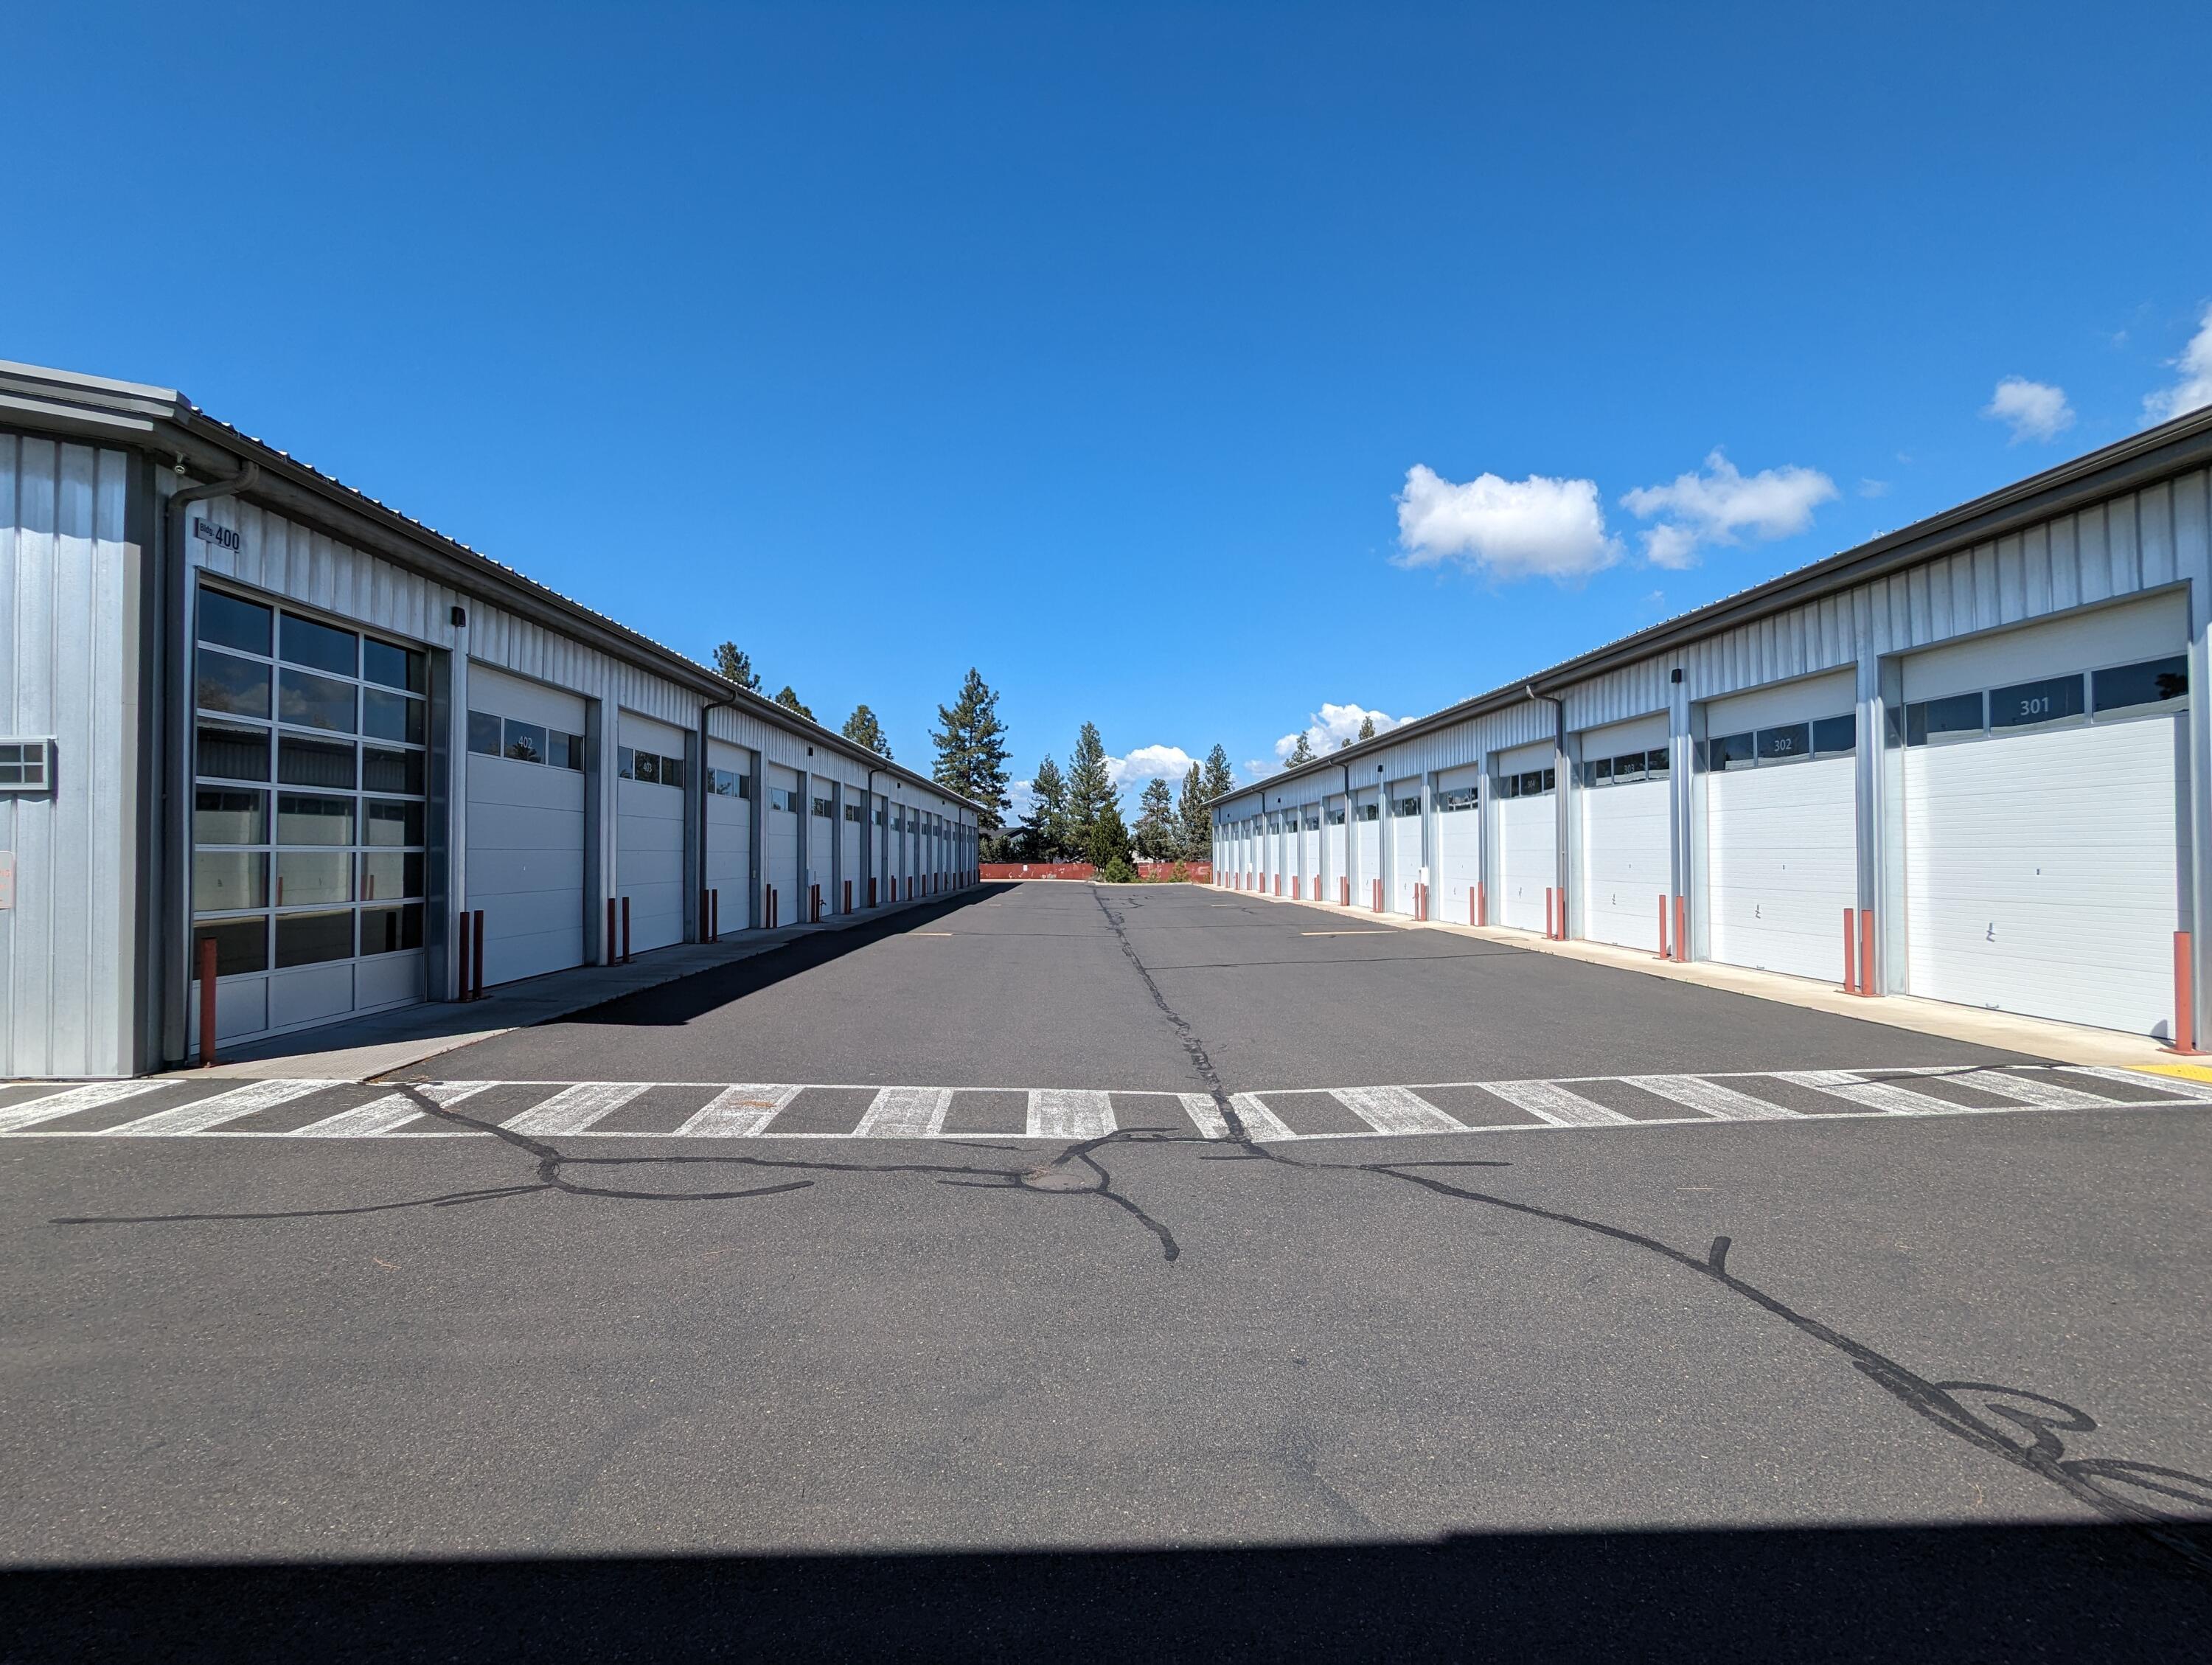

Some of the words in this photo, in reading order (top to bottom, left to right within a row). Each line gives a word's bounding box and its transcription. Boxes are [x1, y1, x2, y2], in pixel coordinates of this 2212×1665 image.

[200, 523, 215, 537] Bldg.
[215, 526, 240, 550] 400
[2020, 697, 2049, 716] 301
[518, 736, 532, 749] 402
[1774, 738, 1792, 751] 302
[643, 762, 653, 773] 403
[1624, 763, 1635, 774] 303
